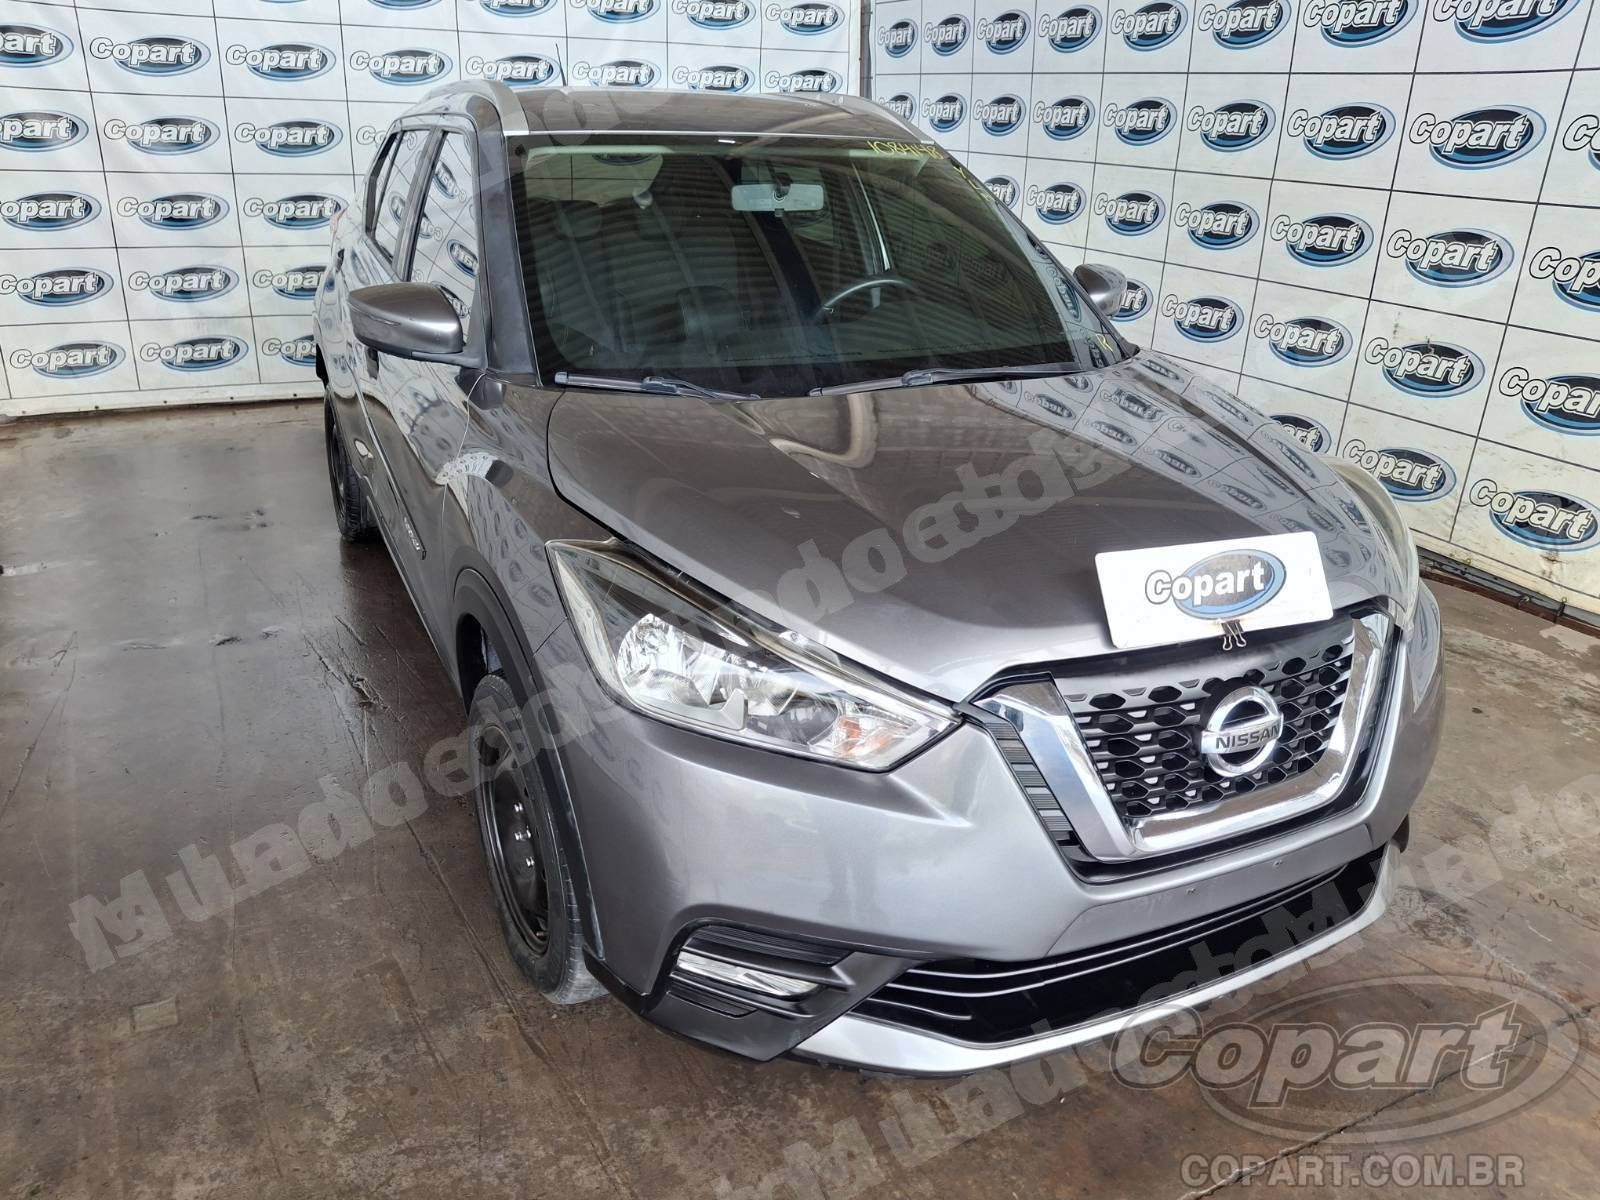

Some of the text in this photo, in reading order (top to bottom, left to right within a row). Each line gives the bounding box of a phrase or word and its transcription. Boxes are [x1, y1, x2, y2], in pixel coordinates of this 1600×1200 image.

[672, 0, 746, 20] Copart
[764, 5, 836, 25] Copart
[1199, 1, 1281, 38] Copart
[1303, 0, 1400, 35] Copart
[1433, 0, 1557, 29] Copart
[877, 23, 914, 49] Copart
[924, 20, 966, 47] Copart
[976, 16, 1025, 45] Copart
[1038, 12, 1096, 42] Copart
[1111, 8, 1178, 41] Copart
[0, 32, 55, 55] art
[90, 37, 196, 66] Copart
[226, 45, 325, 71] Copart
[350, 51, 439, 77] Copart
[466, 56, 551, 84] Copart
[573, 62, 652, 87] Copart
[672, 66, 744, 91] Copart
[764, 71, 836, 94] Copart
[921, 99, 961, 123] Copart
[973, 99, 1022, 125] Copart
[1032, 100, 1088, 128] Copart
[1103, 103, 1168, 133] Copart
[1187, 105, 1266, 139] Copart
[0, 118, 73, 142] part
[104, 119, 205, 146] Copart
[234, 122, 330, 149] Copart
[1287, 108, 1383, 146] Copart
[1408, 113, 1529, 153] Copart
[0, 197, 85, 223] opart
[117, 197, 216, 222] Copart
[243, 197, 336, 221] Copart
[1026, 184, 1079, 212] Copart
[1093, 193, 1157, 224] Copart
[1174, 202, 1250, 236] Copart
[1270, 215, 1362, 252] Copart
[1386, 229, 1498, 271] Copart
[129, 271, 224, 296] Copart
[253, 269, 325, 292] Copa
[1529, 246, 1600, 293] Cop
[0, 273, 99, 299] Copart
[1162, 294, 1234, 330] Copart
[1253, 313, 1343, 355] Copart
[10, 344, 112, 372] Copart
[140, 340, 235, 367] Copart
[1365, 337, 1470, 384] Copart
[1499, 367, 1600, 417] Copar
[1343, 438, 1445, 492] Copart
[1469, 478, 1594, 540] Copart
[1145, 561, 1266, 606] Copart
[1215, 725, 1281, 750] NISSAN
